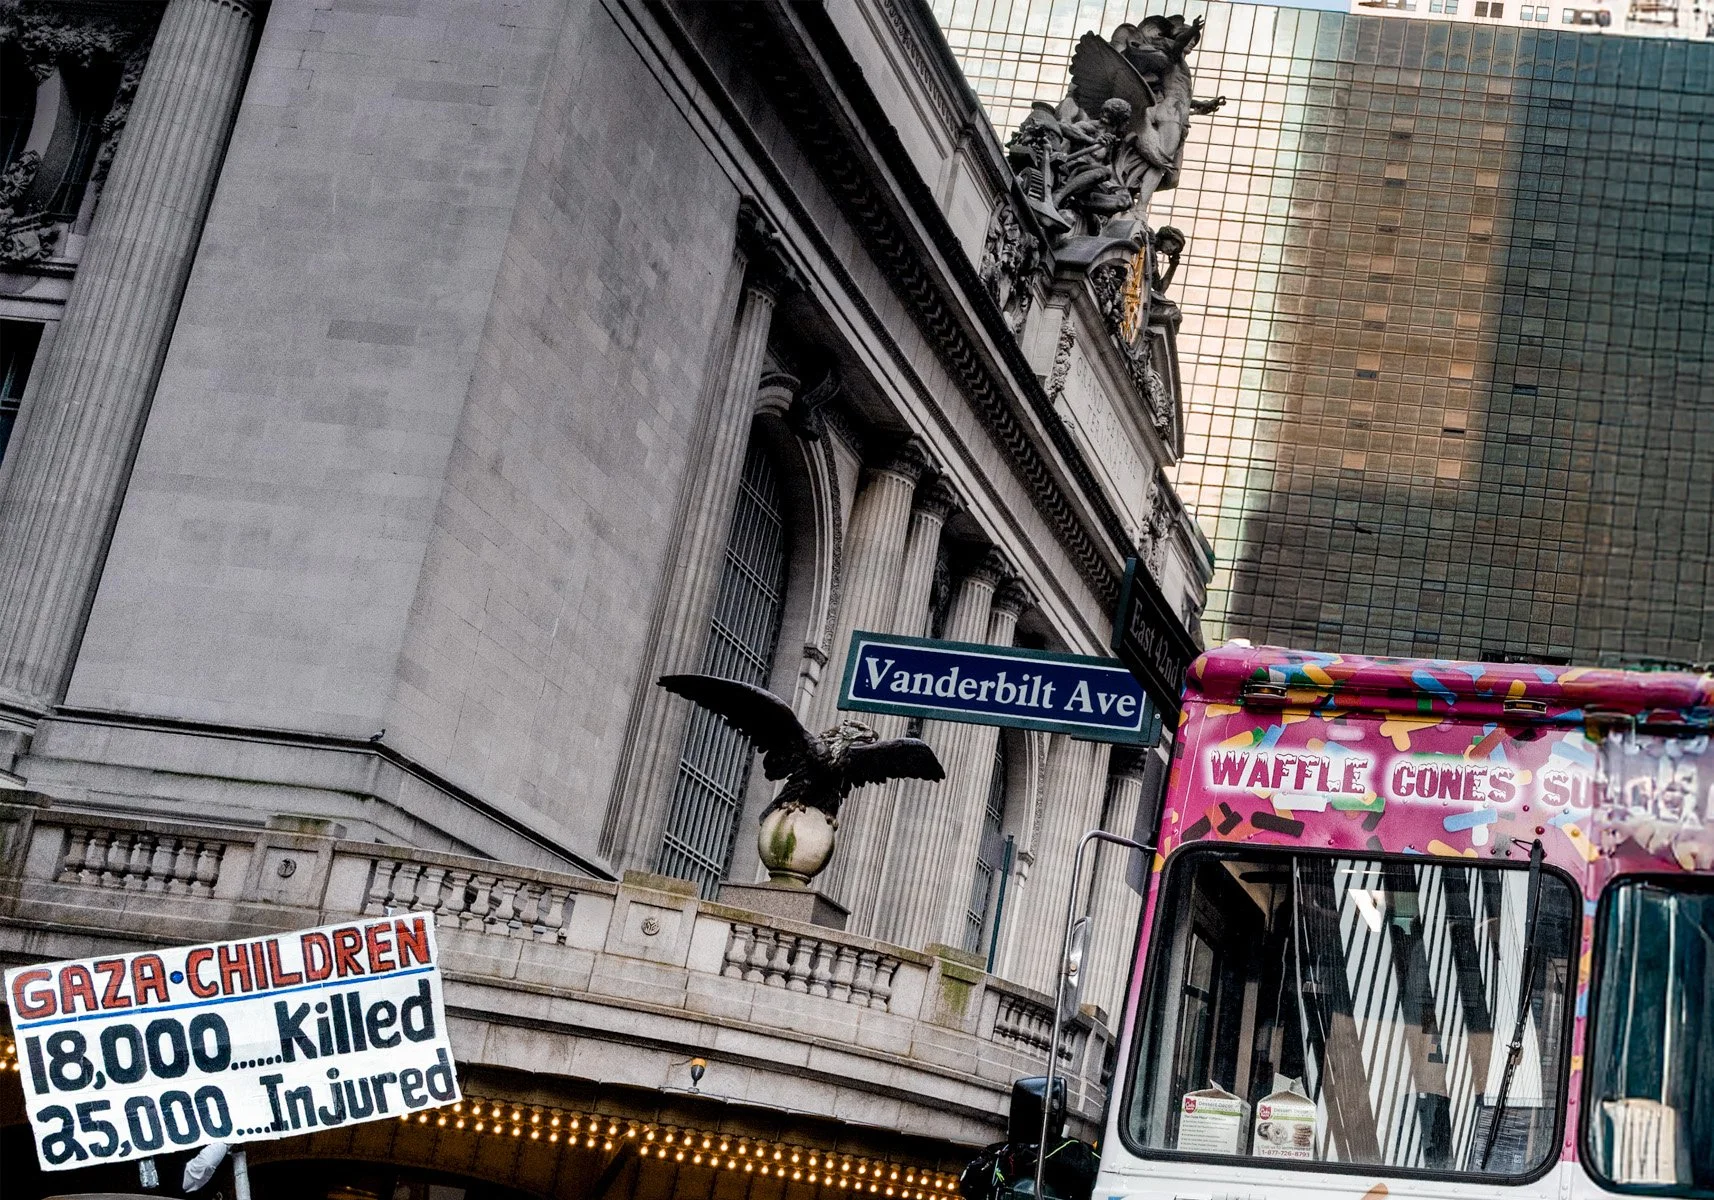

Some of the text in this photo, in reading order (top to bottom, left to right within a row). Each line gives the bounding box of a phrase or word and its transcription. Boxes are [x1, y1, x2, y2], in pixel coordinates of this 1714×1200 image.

[1129, 597, 1156, 659] East
[1154, 634, 1181, 691] 42nd
[865, 656, 1137, 718] Vanderbilt Ave
[1210, 749, 1369, 794] WAFFLE
[1392, 759, 1517, 804] CONES
